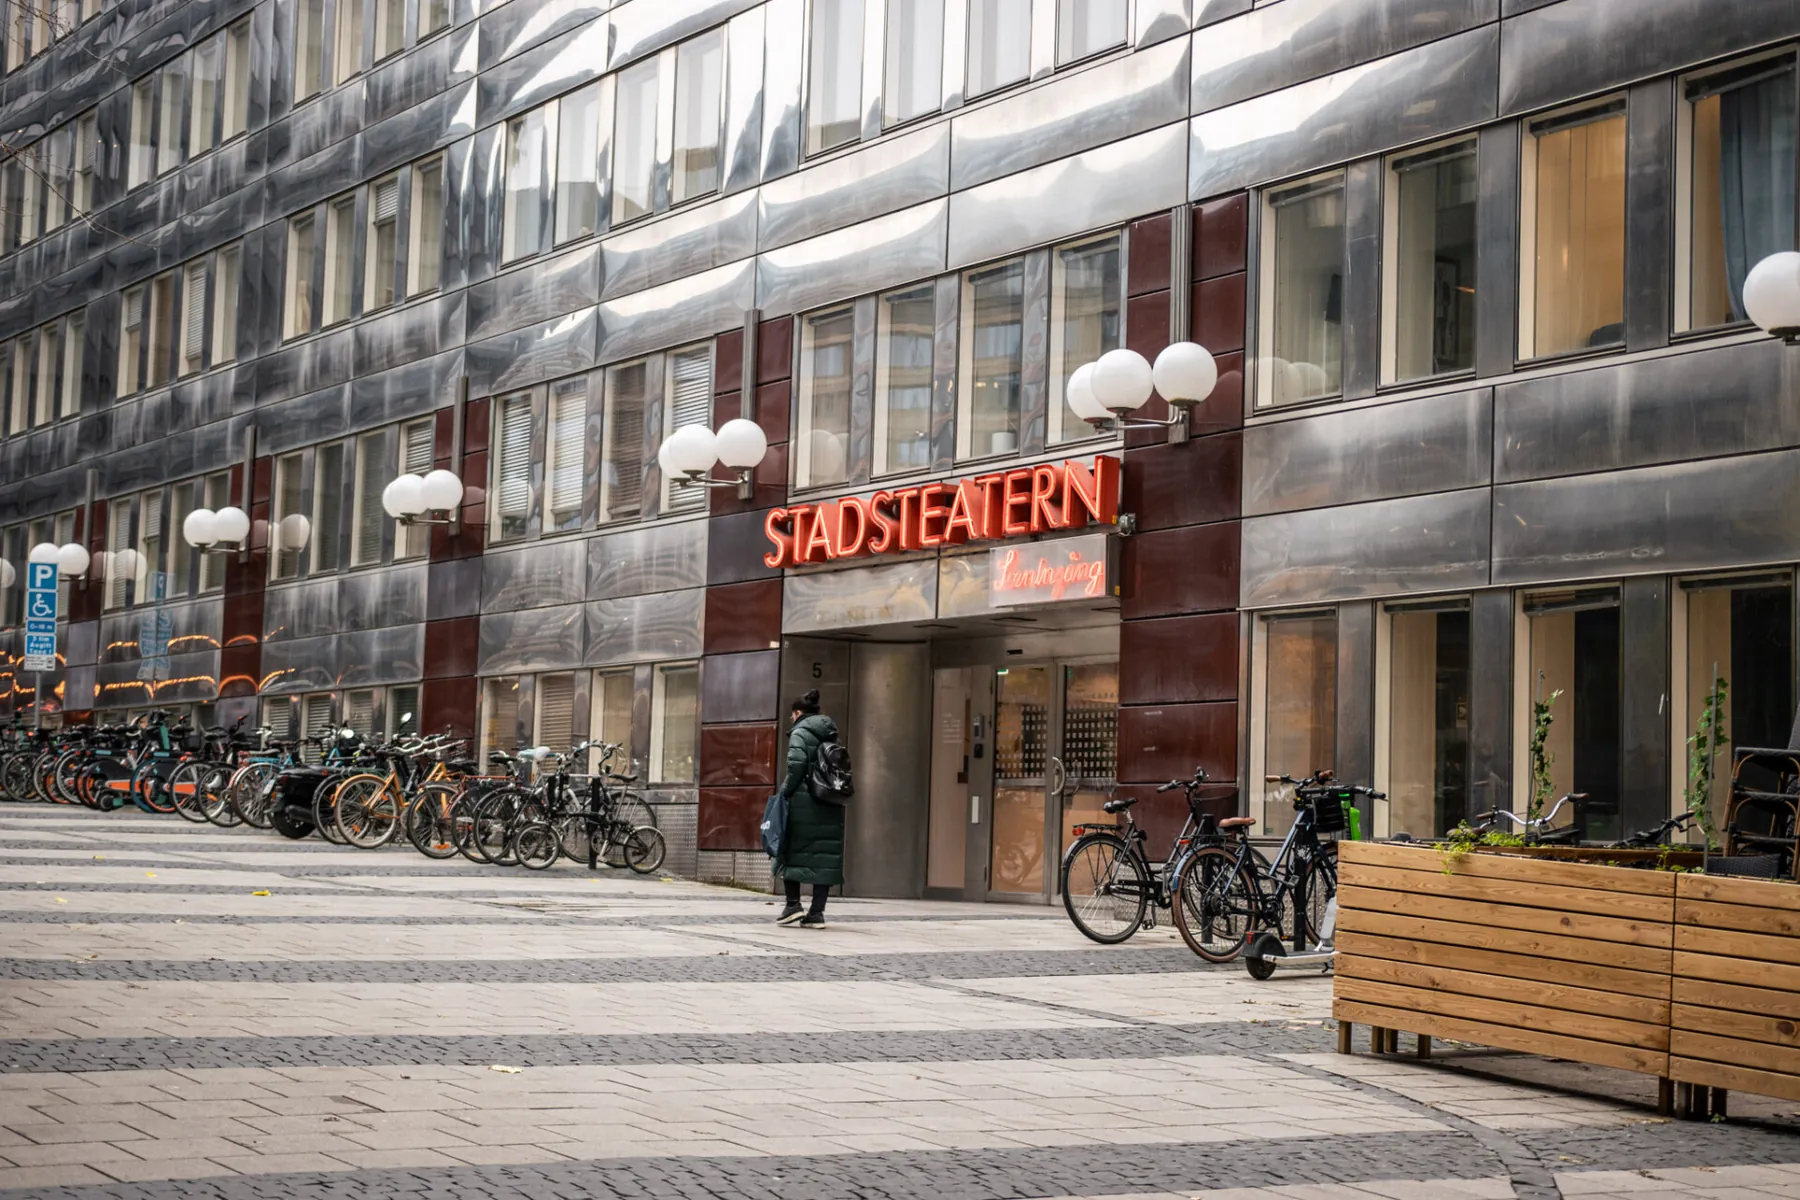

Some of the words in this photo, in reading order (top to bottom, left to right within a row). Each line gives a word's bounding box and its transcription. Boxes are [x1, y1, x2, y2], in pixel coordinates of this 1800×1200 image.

[764, 455, 1120, 568] STADSTEATERN
[35, 565, 53, 588] P
[812, 662, 822, 679] 5
